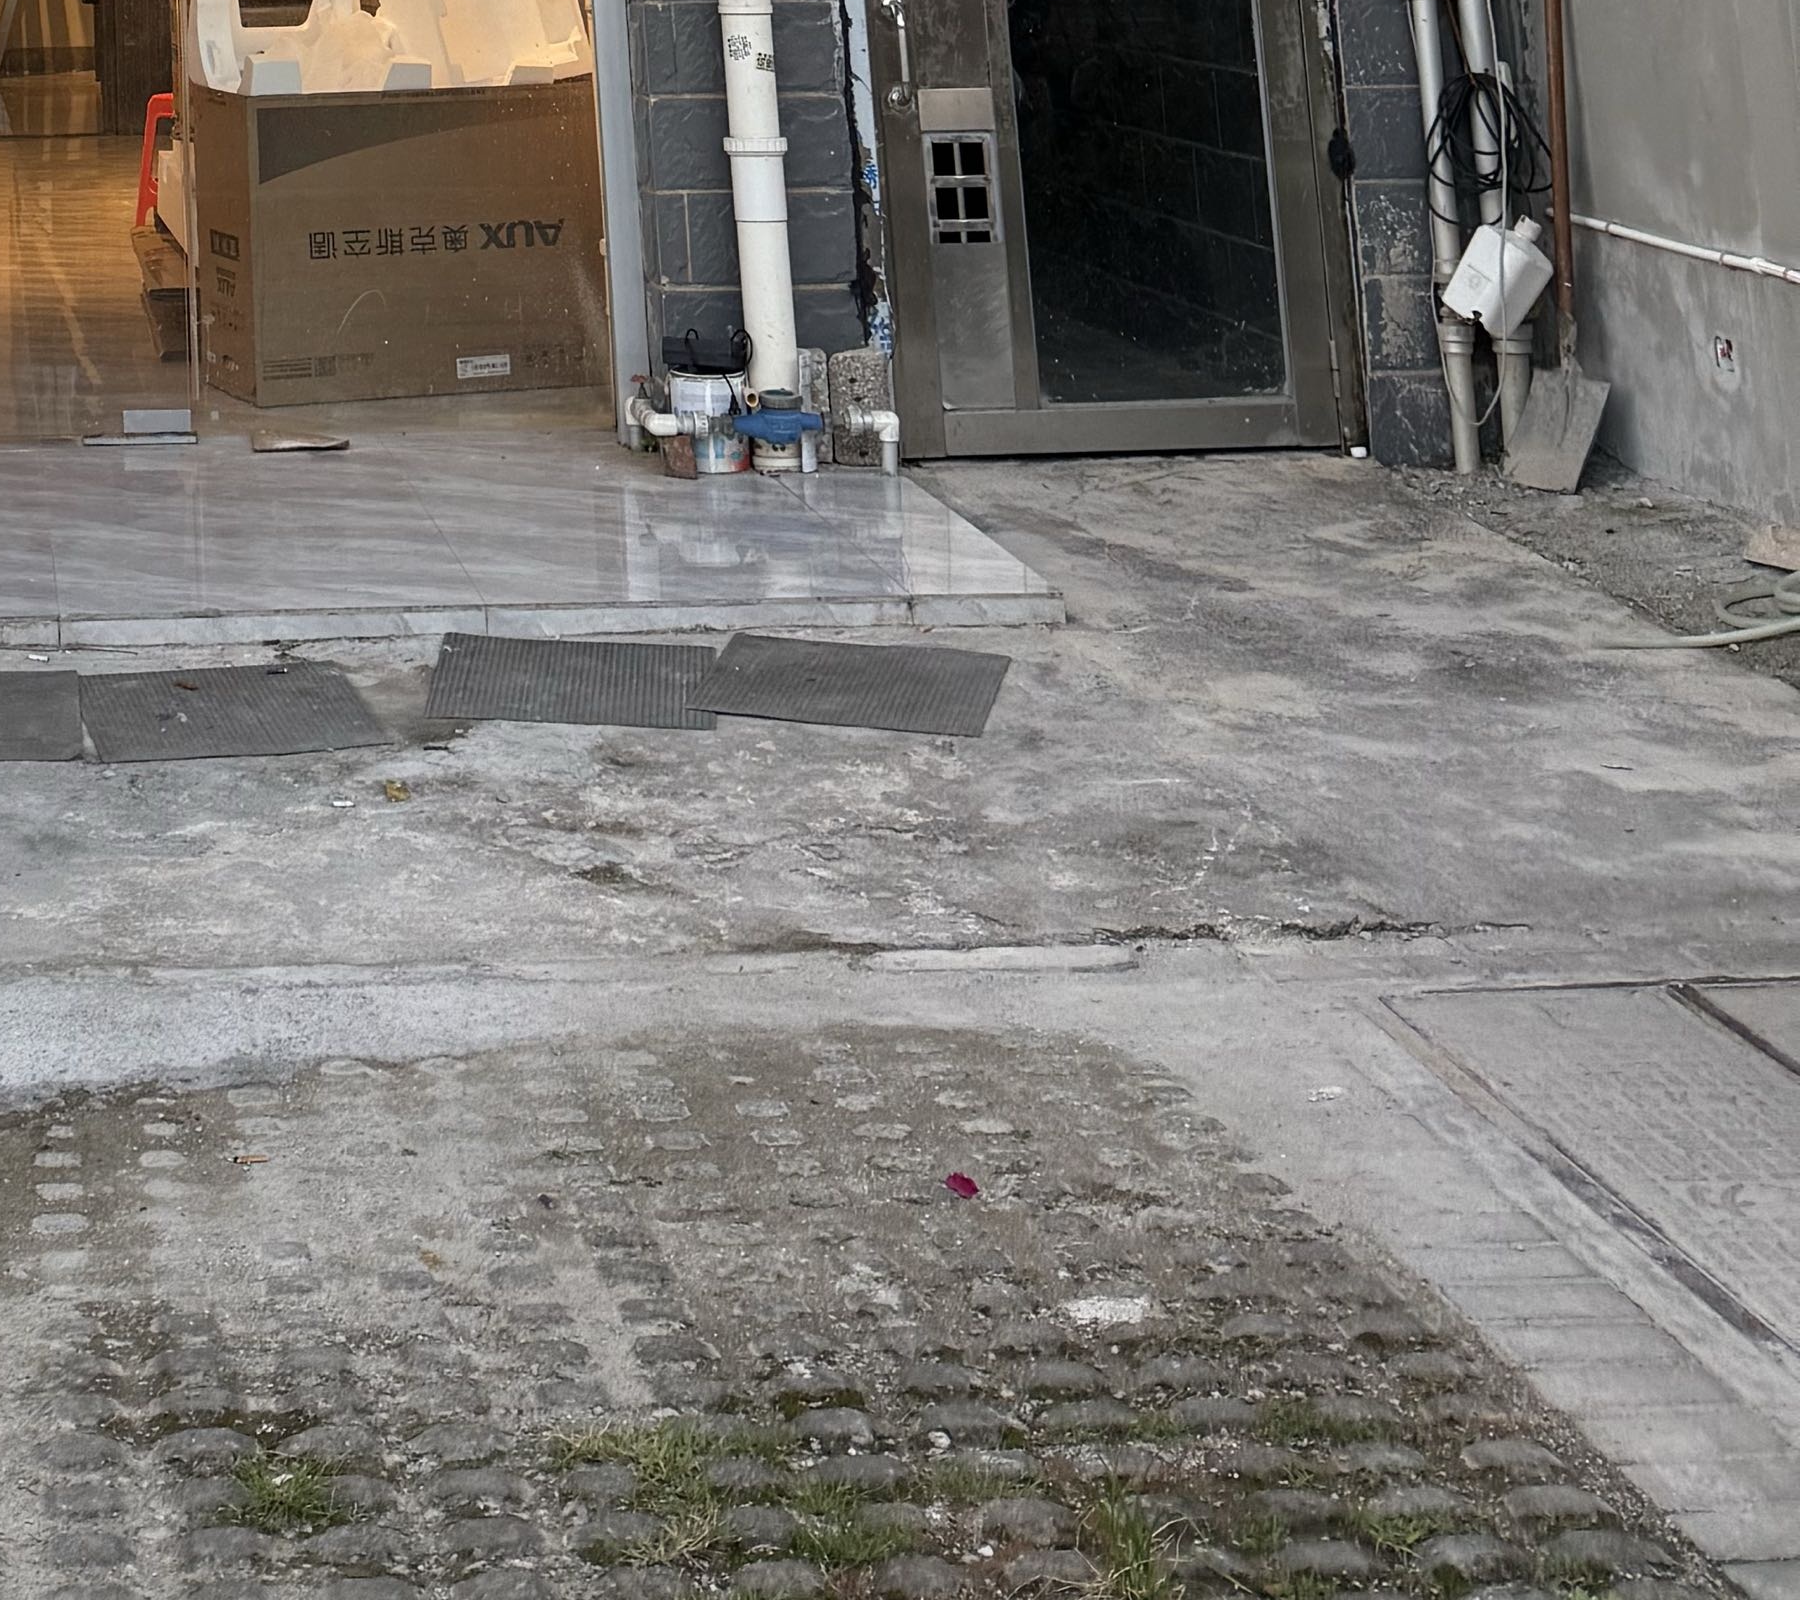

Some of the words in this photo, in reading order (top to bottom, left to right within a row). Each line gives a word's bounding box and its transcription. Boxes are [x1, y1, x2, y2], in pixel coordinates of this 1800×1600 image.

[309, 224, 468, 260] 奥克斯空调
[480, 218, 565, 250] AUX
